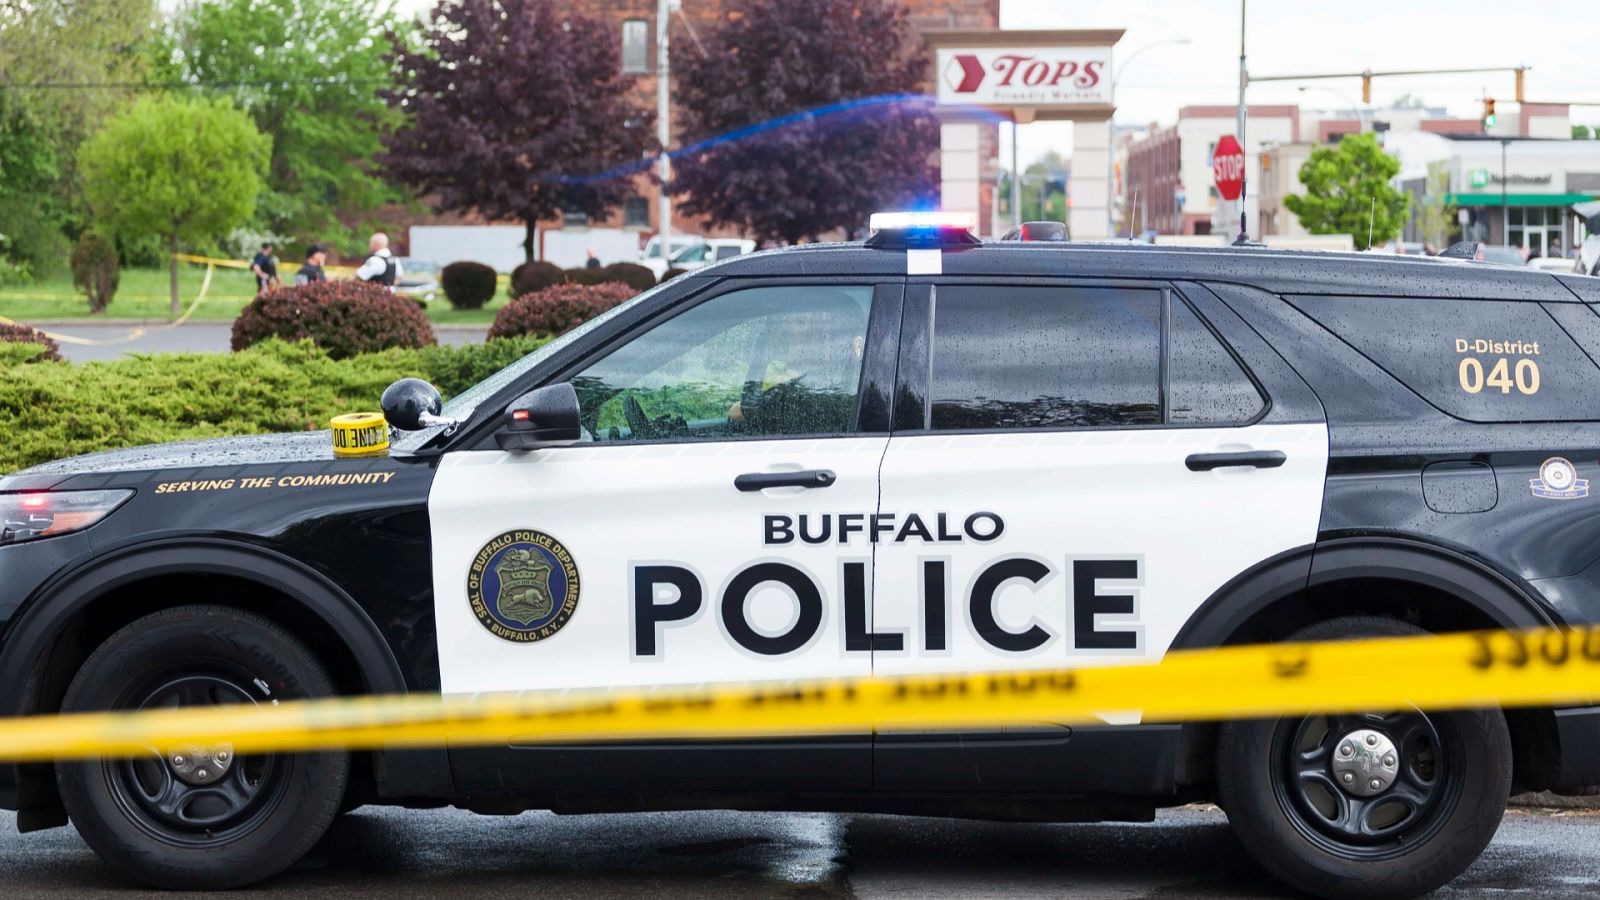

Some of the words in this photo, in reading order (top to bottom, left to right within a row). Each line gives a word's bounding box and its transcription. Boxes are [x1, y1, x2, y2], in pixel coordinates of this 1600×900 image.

[1213, 154, 1245, 182] STOP
[1455, 339, 1540, 355] D-District
[1458, 357, 1541, 395] 040
[334, 427, 347, 448] DO
[154, 478, 236, 494] SERVING
[239, 476, 276, 489] THE
[277, 471, 396, 488] COMMUNITY
[515, 532, 553, 547] POLICE
[763, 511, 1006, 545] BUFFALO
[473, 534, 512, 573] BUFFALO
[469, 573, 480, 589] OF
[552, 544, 579, 616] DEPARTMENT
[470, 591, 487, 618] SEAL
[633, 556, 1140, 657] POLICE
[542, 622, 561, 637] N.Y.
